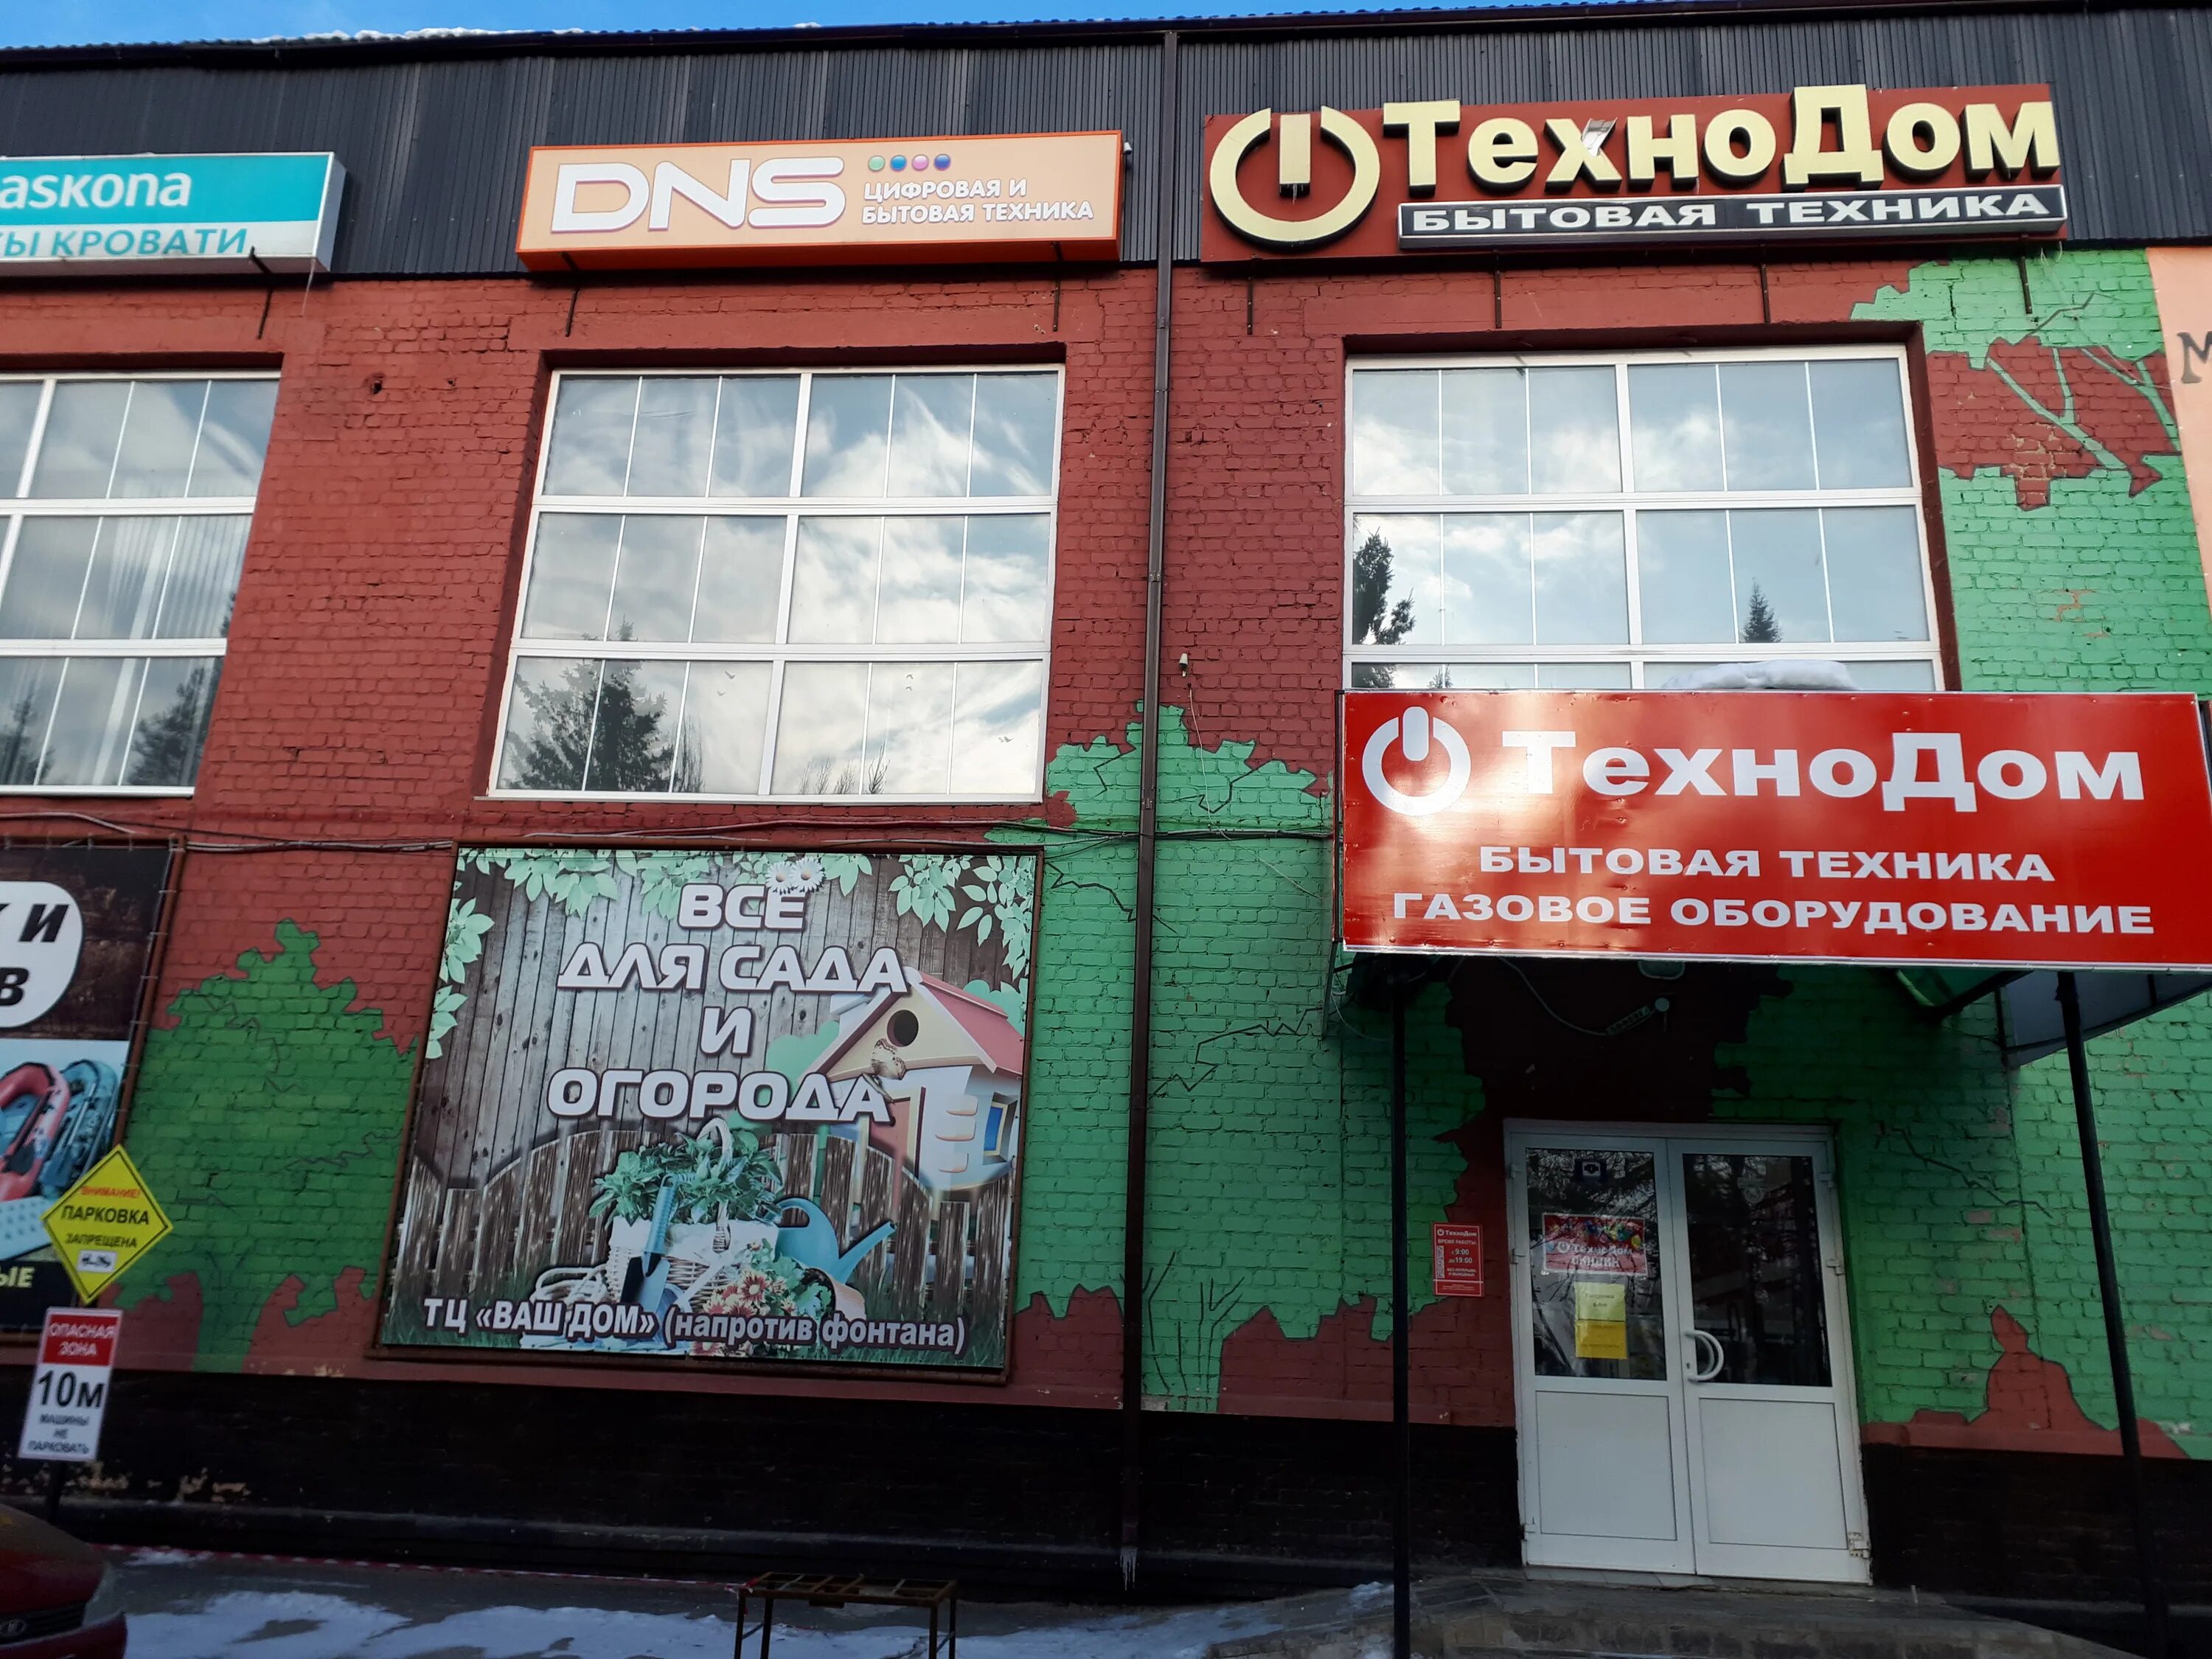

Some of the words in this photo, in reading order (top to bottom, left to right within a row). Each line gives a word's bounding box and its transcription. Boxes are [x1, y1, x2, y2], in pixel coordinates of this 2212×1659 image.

[1383, 84, 2061, 193] ТехноДом
[0, 170, 192, 209] askona
[551, 156, 845, 234] DNS
[864, 178, 1001, 203] ЦИФРОВАЯ
[1009, 178, 1026, 197] И
[862, 203, 975, 224] БЫТОВАЯ
[982, 201, 1094, 222] ТЕХНИКА
[1413, 205, 1716, 232] БЫТОВАЯ
[1747, 193, 2051, 225] ТЕХНИКА
[0, 230, 40, 257] Ы
[52, 228, 247, 257] КРОВАТИ
[1501, 730, 2145, 813] ТехноДом
[1480, 846, 1761, 877] БЫТОВАЯ
[1779, 849, 2056, 882] ТЕХНИКА
[1393, 892, 1652, 925] ГАЗОВОЕ
[1670, 898, 2154, 935] ОБОРУДОВАНИЕ
[557, 943, 706, 990] ДЛЯ
[720, 944, 909, 993] САДА
[700, 1006, 752, 1055] И
[548, 1067, 894, 1124] ОГОРОДА
[80, 1186, 141, 1199] ВНИМАНИЕ!
[60, 1205, 150, 1225] ПАРКОВКА
[66, 1233, 138, 1248] ЗАПРЕЩЕНА
[49, 1321, 116, 1338] ОПАСНАЯ
[423, 1298, 468, 1333] ТЦ
[476, 1301, 563, 1332] «ВАШ
[568, 1304, 655, 1338] ДОМ»
[664, 1306, 812, 1346] (напротив
[822, 1312, 965, 1354] фонтана)
[58, 1340, 97, 1356] ЗОНА
[40, 1413, 89, 1426] МАШИНЫ
[53, 1428, 69, 1439] НЕ
[28, 1440, 89, 1455] ПАРКОВАТЬ
